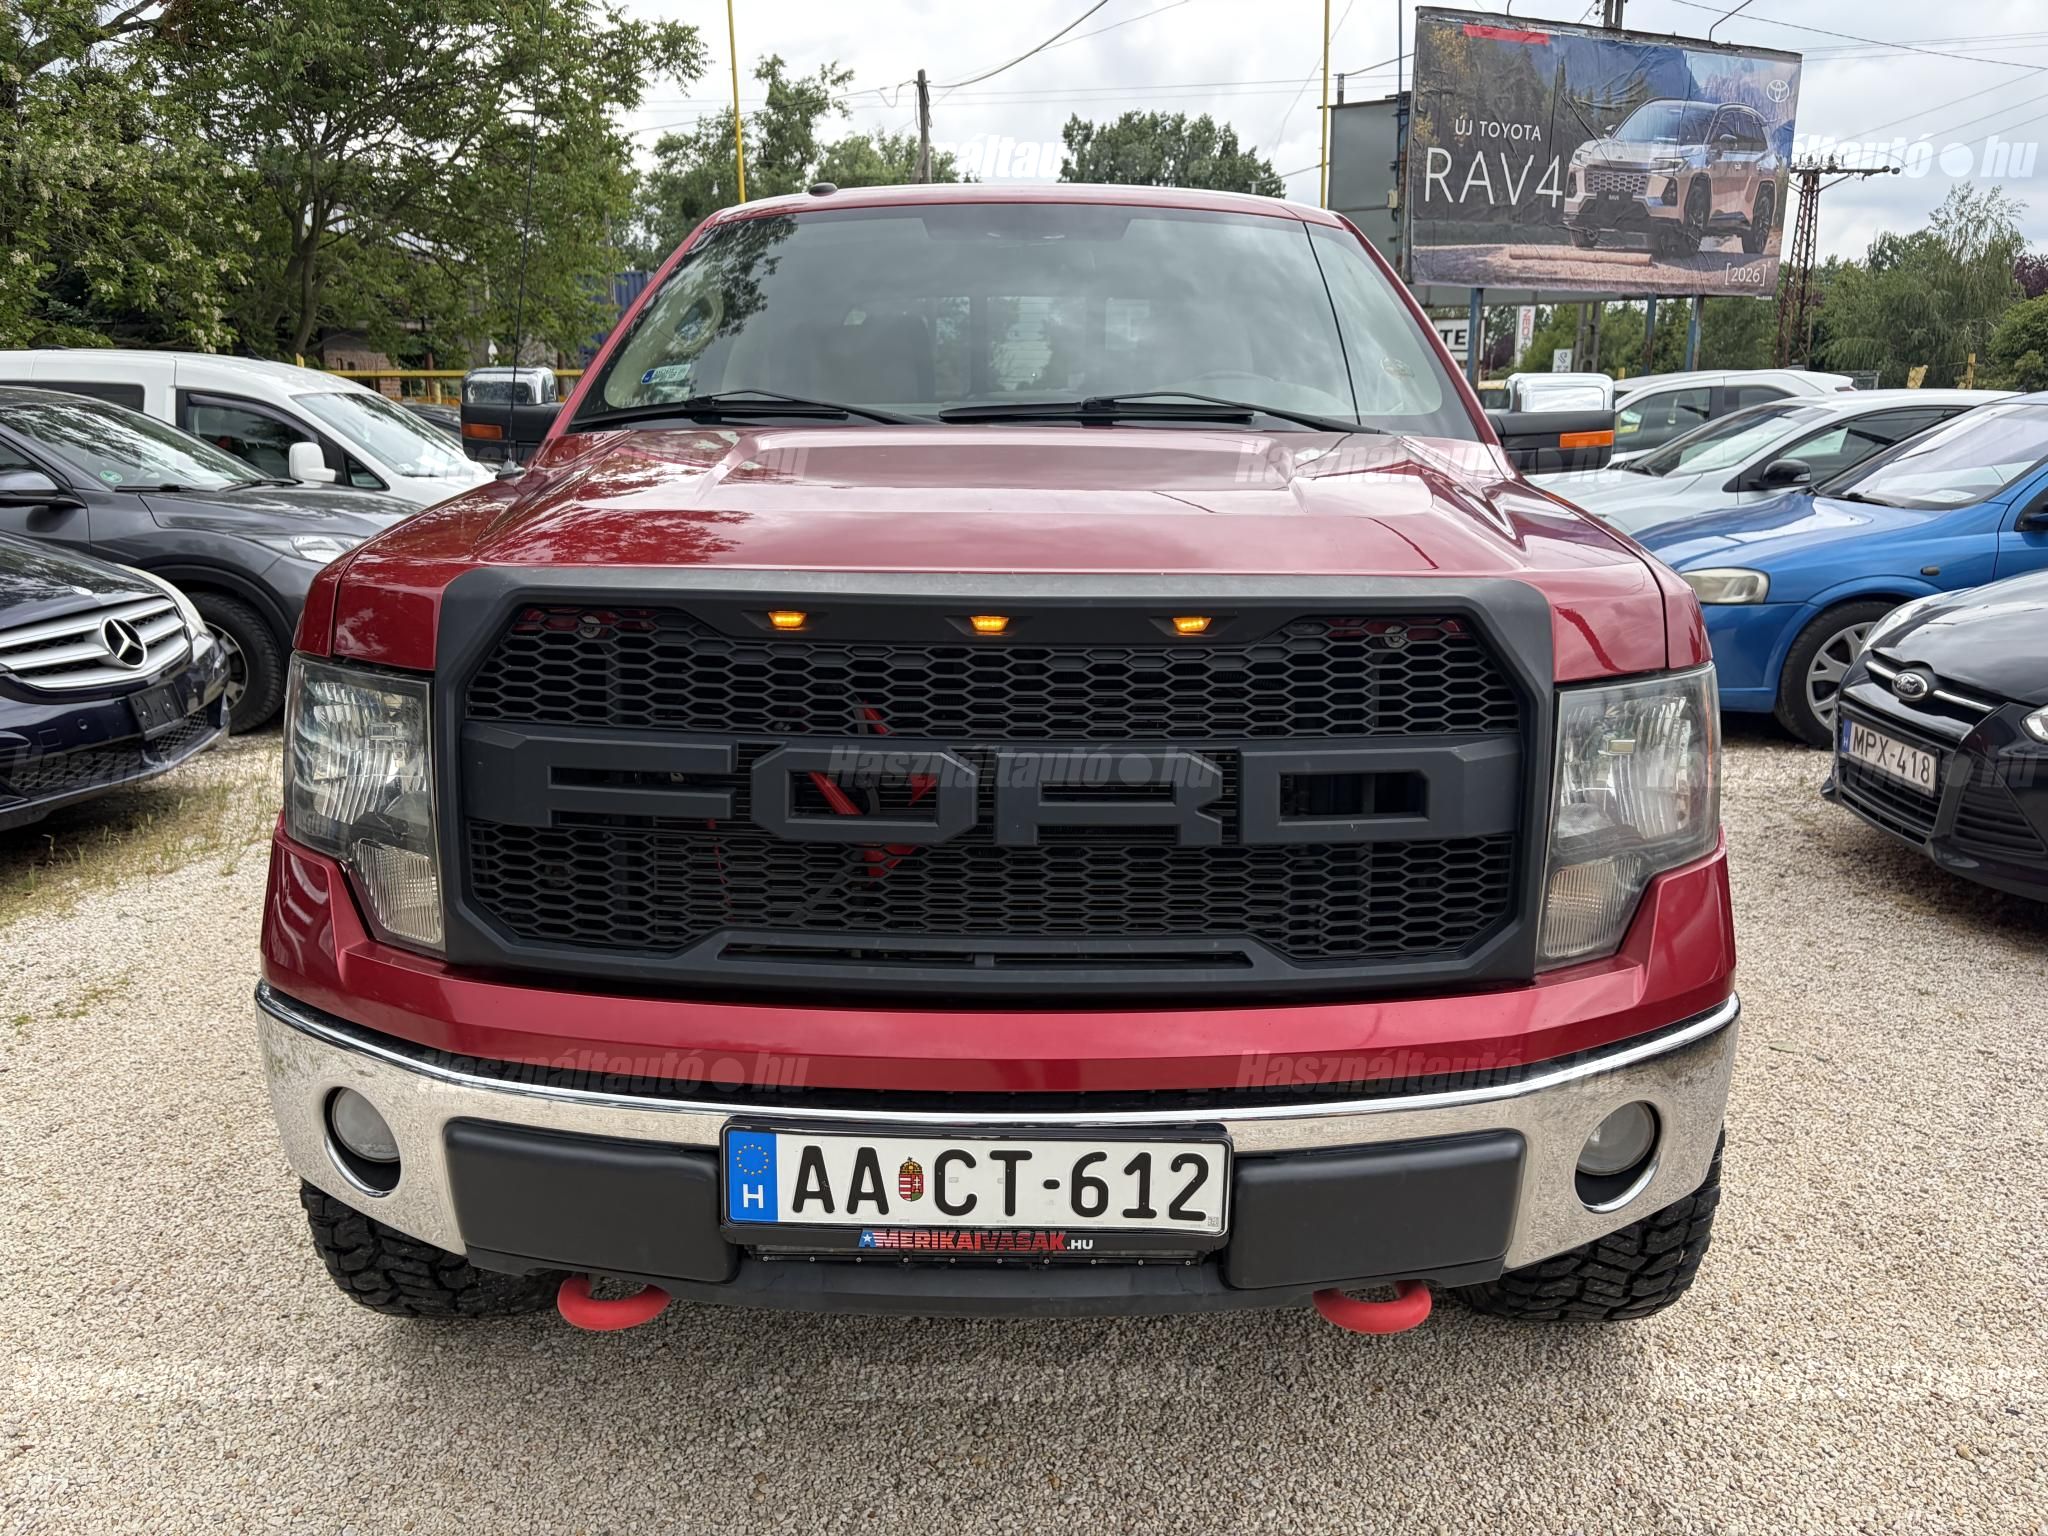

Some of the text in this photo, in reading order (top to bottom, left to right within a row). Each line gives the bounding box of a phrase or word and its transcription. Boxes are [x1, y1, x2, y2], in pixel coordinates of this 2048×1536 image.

[1455, 114, 1542, 142] ÚJ TOYOTA
[1425, 147, 1564, 208] RAV4
[1852, 727, 1931, 783] MPX-418
[464, 728, 1520, 846] FORD
[741, 1184, 764, 1209] H
[792, 1144, 1208, 1221] AA CT-612
